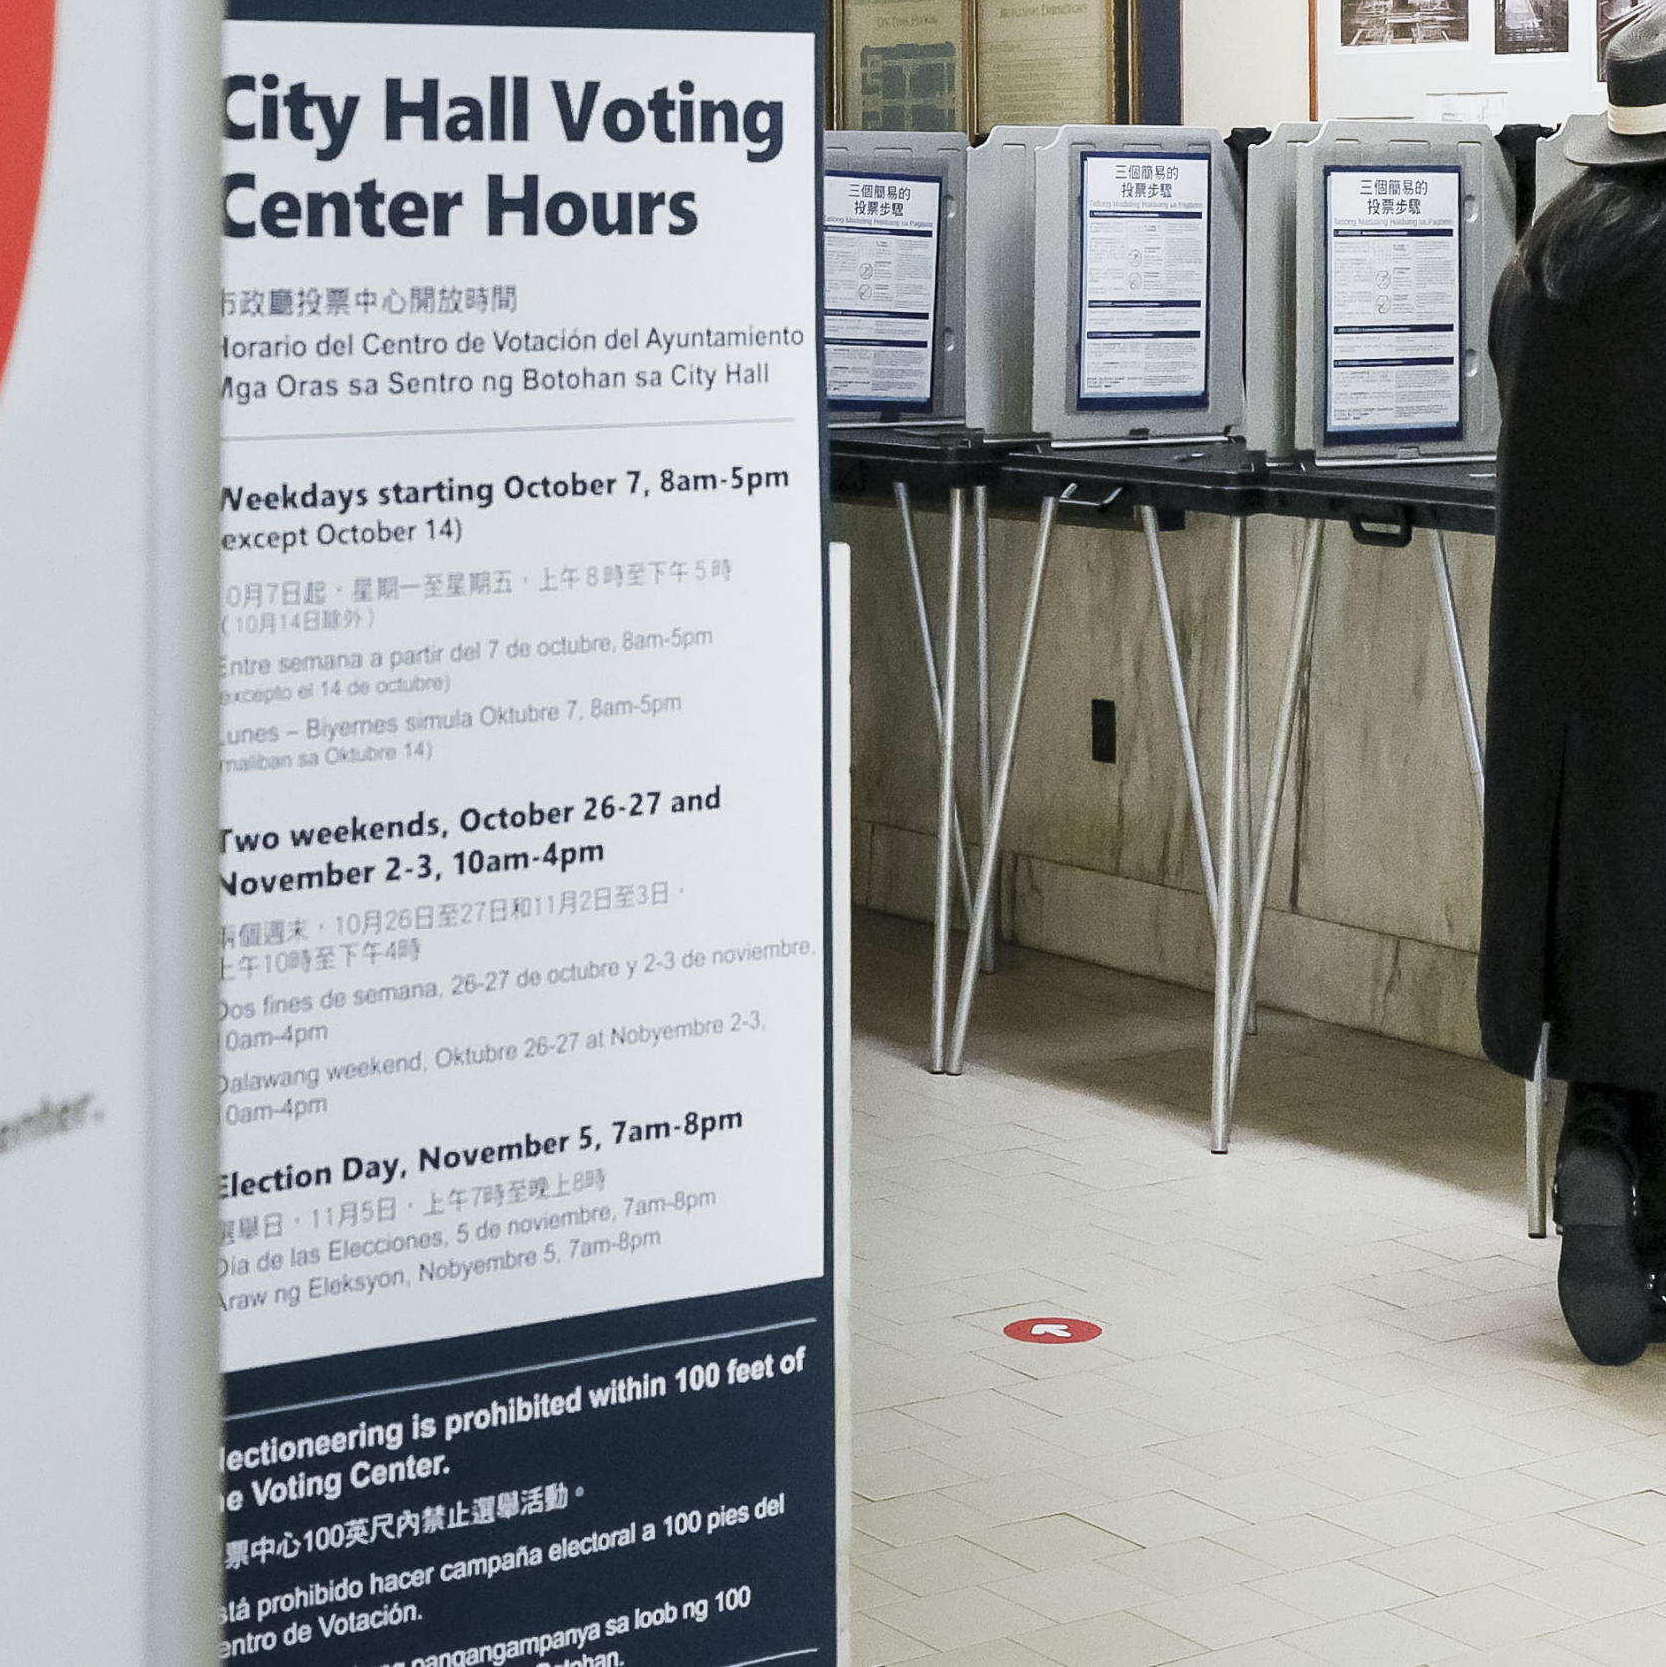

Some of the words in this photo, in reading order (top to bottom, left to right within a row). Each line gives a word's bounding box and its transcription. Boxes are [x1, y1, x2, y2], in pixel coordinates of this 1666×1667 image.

[222, 74, 360, 161] City
[386, 76, 528, 142] Hall
[551, 80, 783, 163] Voting
[222, 173, 462, 238] Center
[488, 174, 697, 236] Hours
[316, 334, 352, 356] del
[363, 333, 447, 355] Centro
[457, 332, 485, 353] de
[493, 330, 596, 352] Votación
[605, 328, 638, 350] del
[646, 328, 803, 355] Ayuntamiento
[277, 374, 338, 397] Oras
[349, 379, 378, 395] sa
[389, 371, 473, 394] Sentro
[483, 375, 512, 397] ng
[524, 367, 625, 390] Botohan
[636, 371, 661, 387] sa
[672, 365, 716, 390] City
[727, 363, 768, 383] Hall
[379, 478, 493, 508] starting
[505, 472, 616, 499] October
[627, 471, 648, 497] 7,
[661, 467, 788, 496] 8am-5pm
[318, 521, 416, 545] October
[427, 518, 461, 542] 14)
[291, 811, 447, 847] weekends,
[460, 801, 574, 832] October
[584, 792, 660, 821] 26-27
[672, 785, 720, 813] and
[386, 854, 440, 881] 2-3,
[454, 842, 603, 875] 10am-4pm
[343, 1154, 406, 1188] Day,
[420, 1133, 569, 1172] November
[580, 1126, 600, 1151] 5,
[613, 1112, 742, 1144] 7am-8pm
[220, 1422, 403, 1472] lectioneering
[412, 1413, 436, 1440] is
[445, 1386, 581, 1441] prohibited
[589, 1373, 666, 1408] within
[675, 1362, 720, 1392] 100
[727, 1354, 774, 1384] feet
[780, 1346, 806, 1374] of
[251, 1472, 341, 1506] Voting
[350, 1455, 449, 1488] Center.
[258, 1578, 363, 1620] prohibido
[370, 1567, 434, 1594] hacer
[440, 1546, 542, 1581] campaña
[548, 1522, 635, 1561] electoral
[642, 1523, 655, 1541] a
[664, 1510, 701, 1537] 100
[707, 1505, 749, 1534] pies
[754, 1493, 784, 1519] del
[283, 1622, 312, 1646] de
[318, 1604, 422, 1638] Votación.
[606, 1619, 629, 1635] sa
[634, 1604, 678, 1629] loob
[683, 1602, 709, 1623] ng
[715, 1584, 752, 1613] 100
